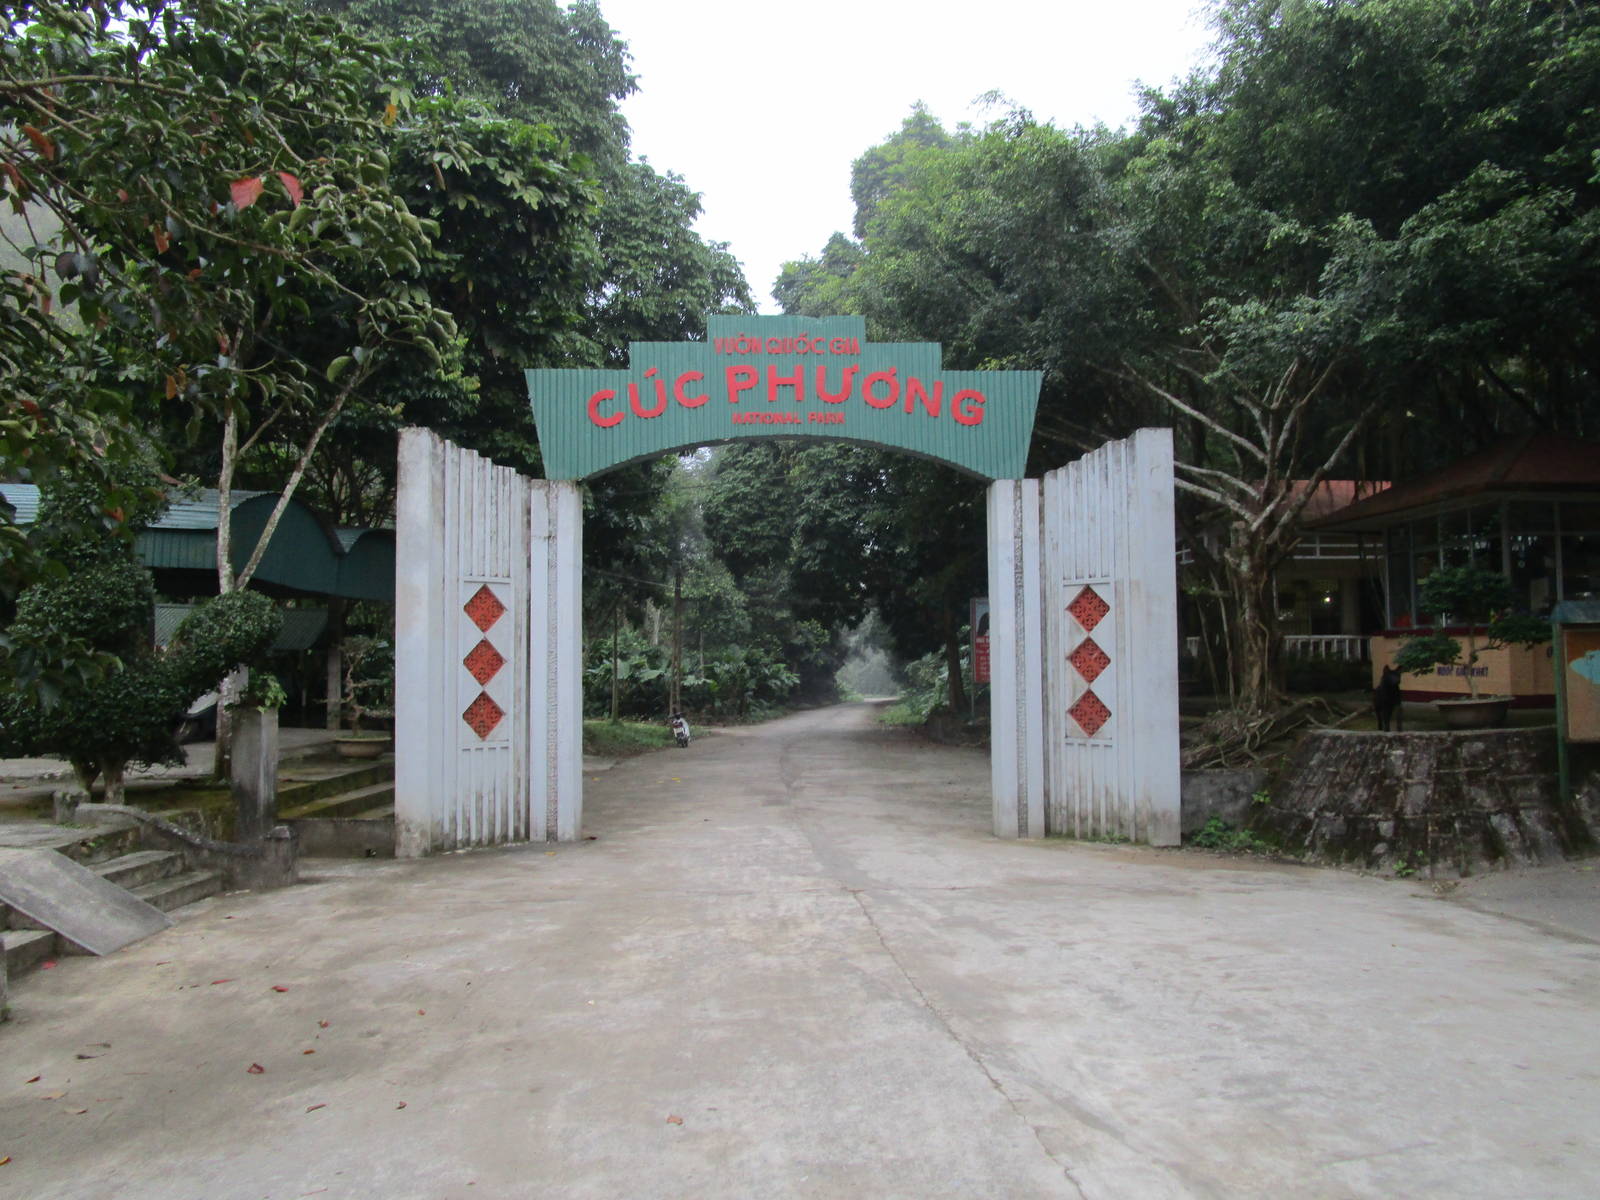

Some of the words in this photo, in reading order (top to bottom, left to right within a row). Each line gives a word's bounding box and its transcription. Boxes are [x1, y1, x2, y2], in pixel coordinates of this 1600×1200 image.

[829, 337, 861, 355] GIA
[588, 368, 709, 427] CÚC
[726, 364, 986, 426] PHƯƠNG
[732, 411, 802, 425] NATIONAL
[807, 411, 846, 425] PARK
